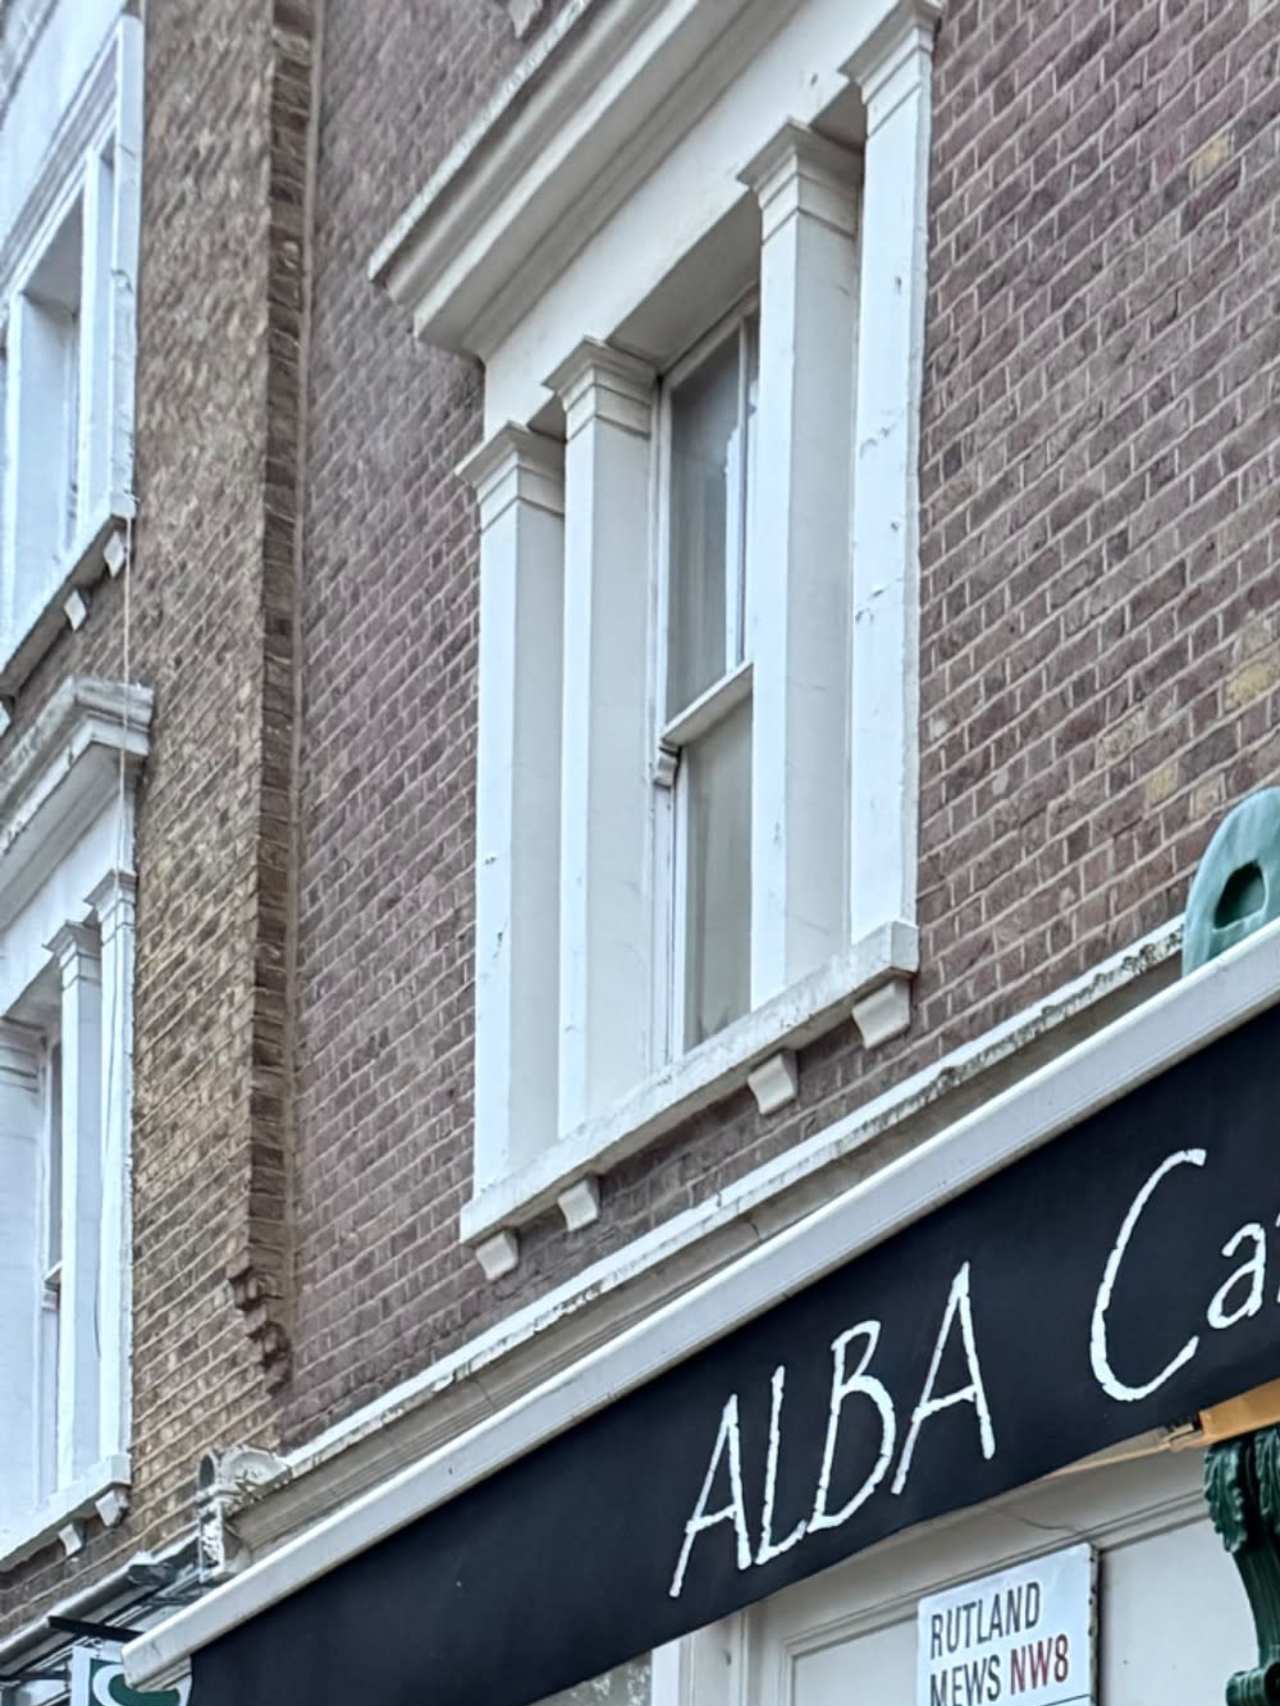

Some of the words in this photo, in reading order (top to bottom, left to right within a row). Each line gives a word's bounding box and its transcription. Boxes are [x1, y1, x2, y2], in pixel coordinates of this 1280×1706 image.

[669, 1261, 995, 1599] ALBA
[930, 1581, 1041, 1661] RUTLAND
[1010, 1633, 1069, 1696] NW8
